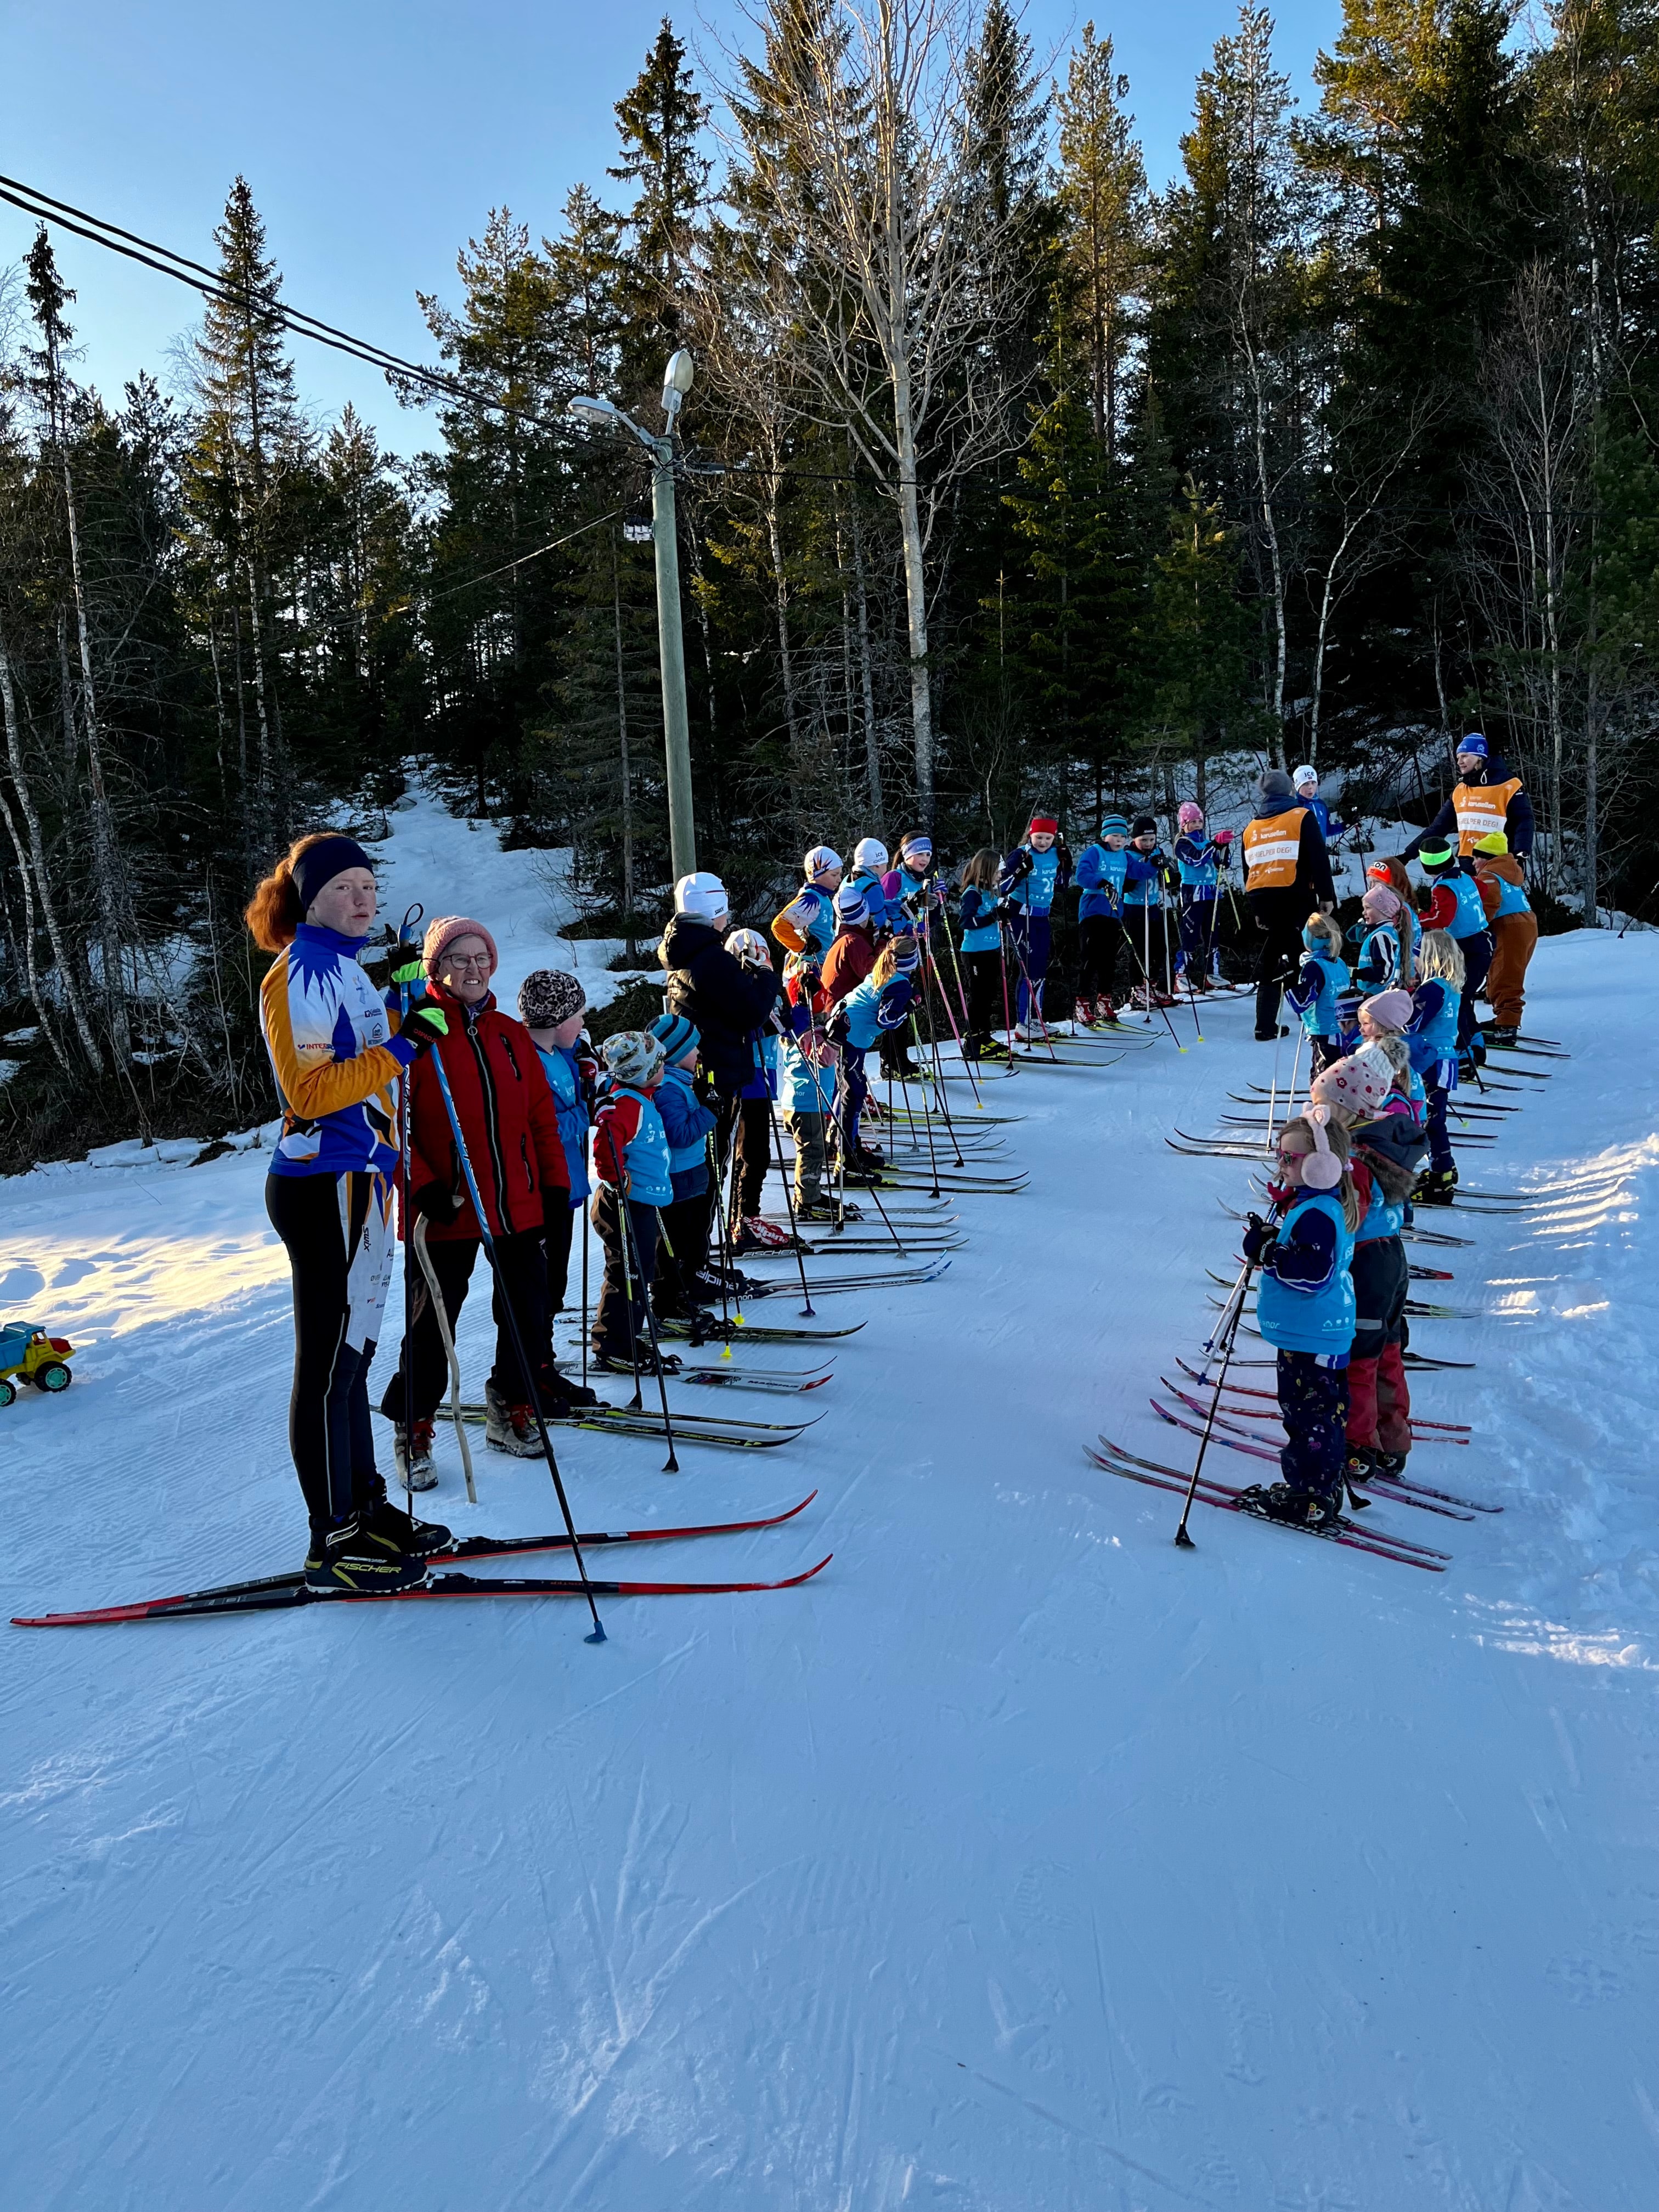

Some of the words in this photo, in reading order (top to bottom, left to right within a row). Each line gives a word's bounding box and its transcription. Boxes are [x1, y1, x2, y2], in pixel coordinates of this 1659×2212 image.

[363, 1226, 371, 1252] Swix
[742, 1249, 797, 1257] FISCHER
[335, 1562, 402, 1573] FISCHER
